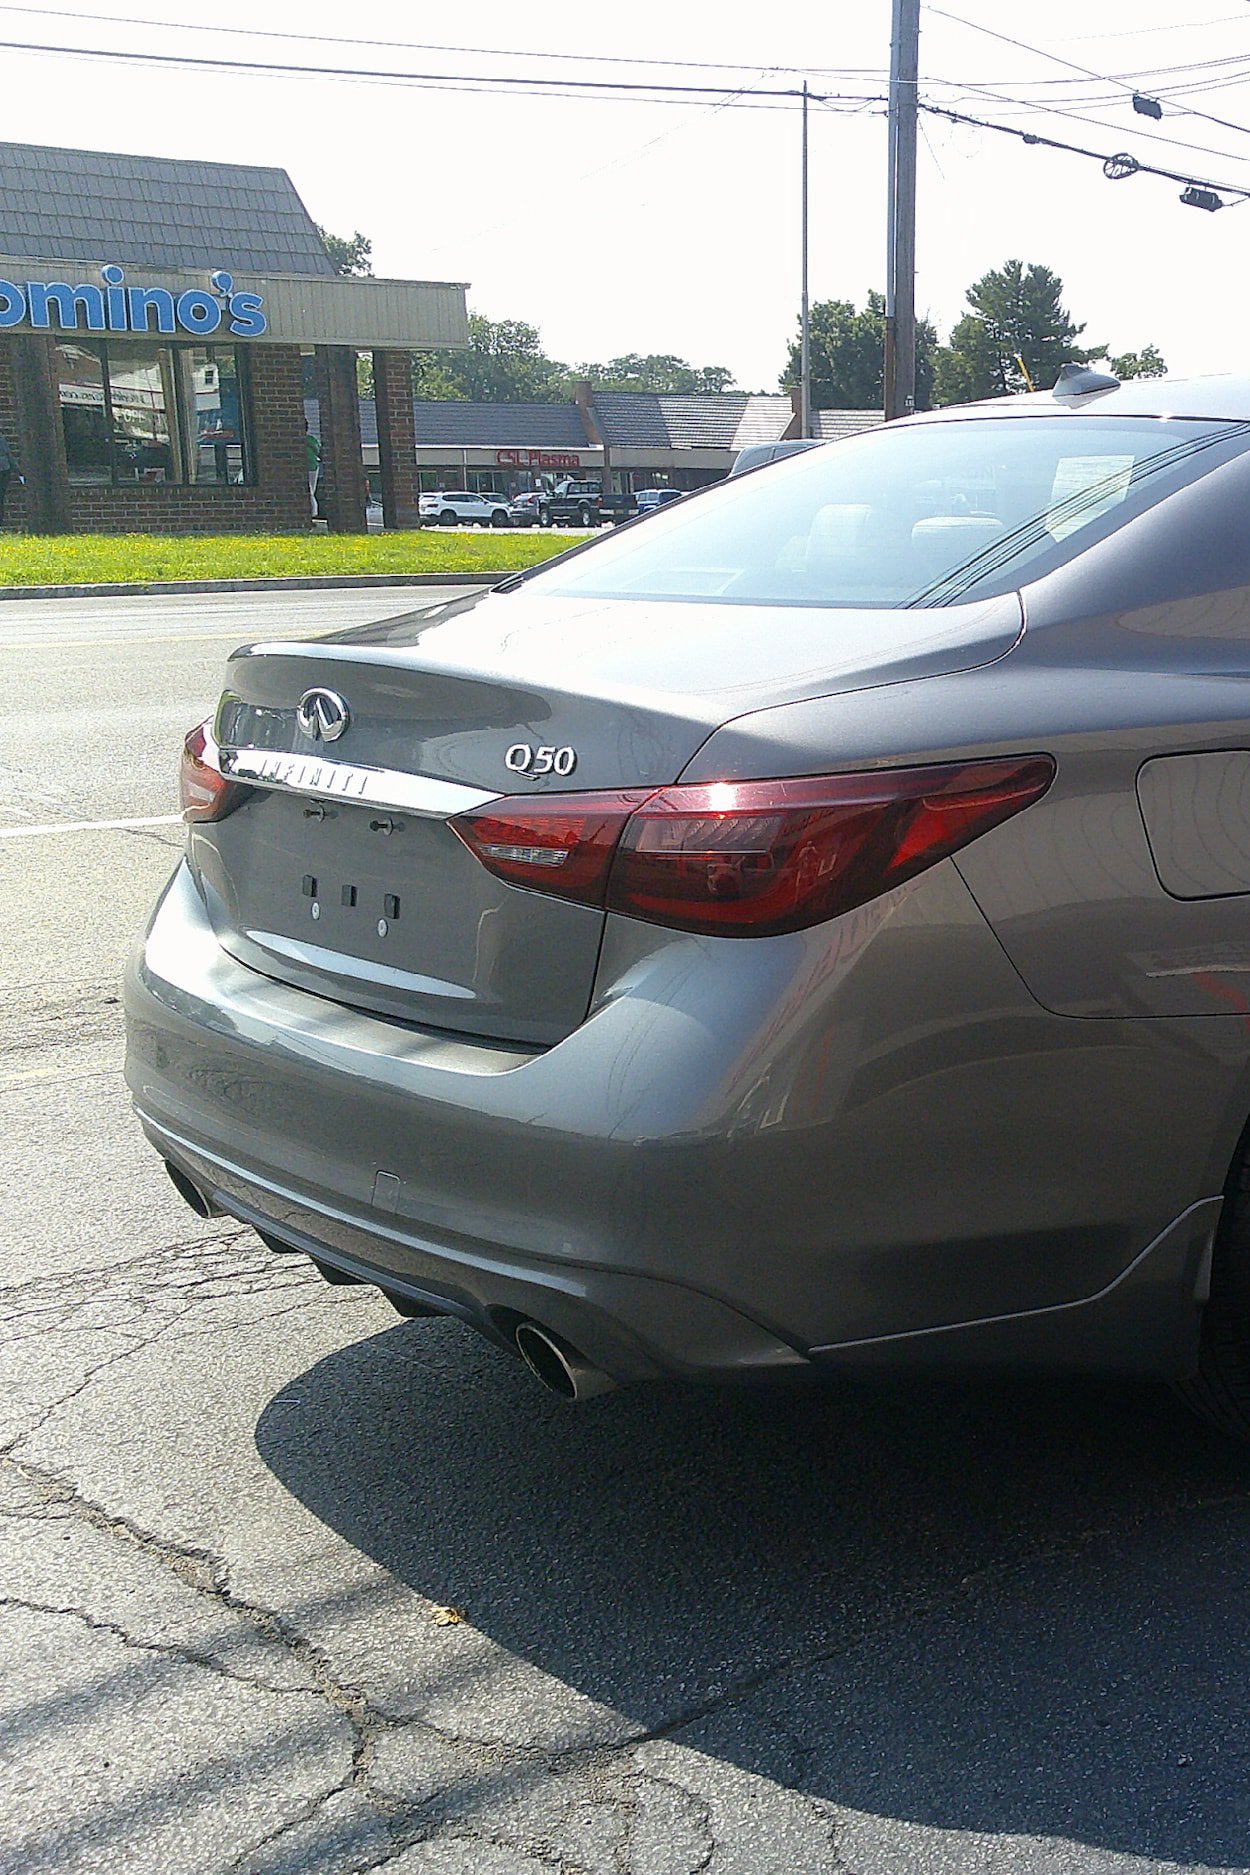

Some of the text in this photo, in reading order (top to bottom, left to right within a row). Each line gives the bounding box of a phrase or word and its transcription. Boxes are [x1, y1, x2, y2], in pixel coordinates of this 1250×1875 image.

[496, 449, 580, 467] CSL Plasma
[258, 759, 368, 795] INFINITI
[505, 743, 577, 781] Q50
